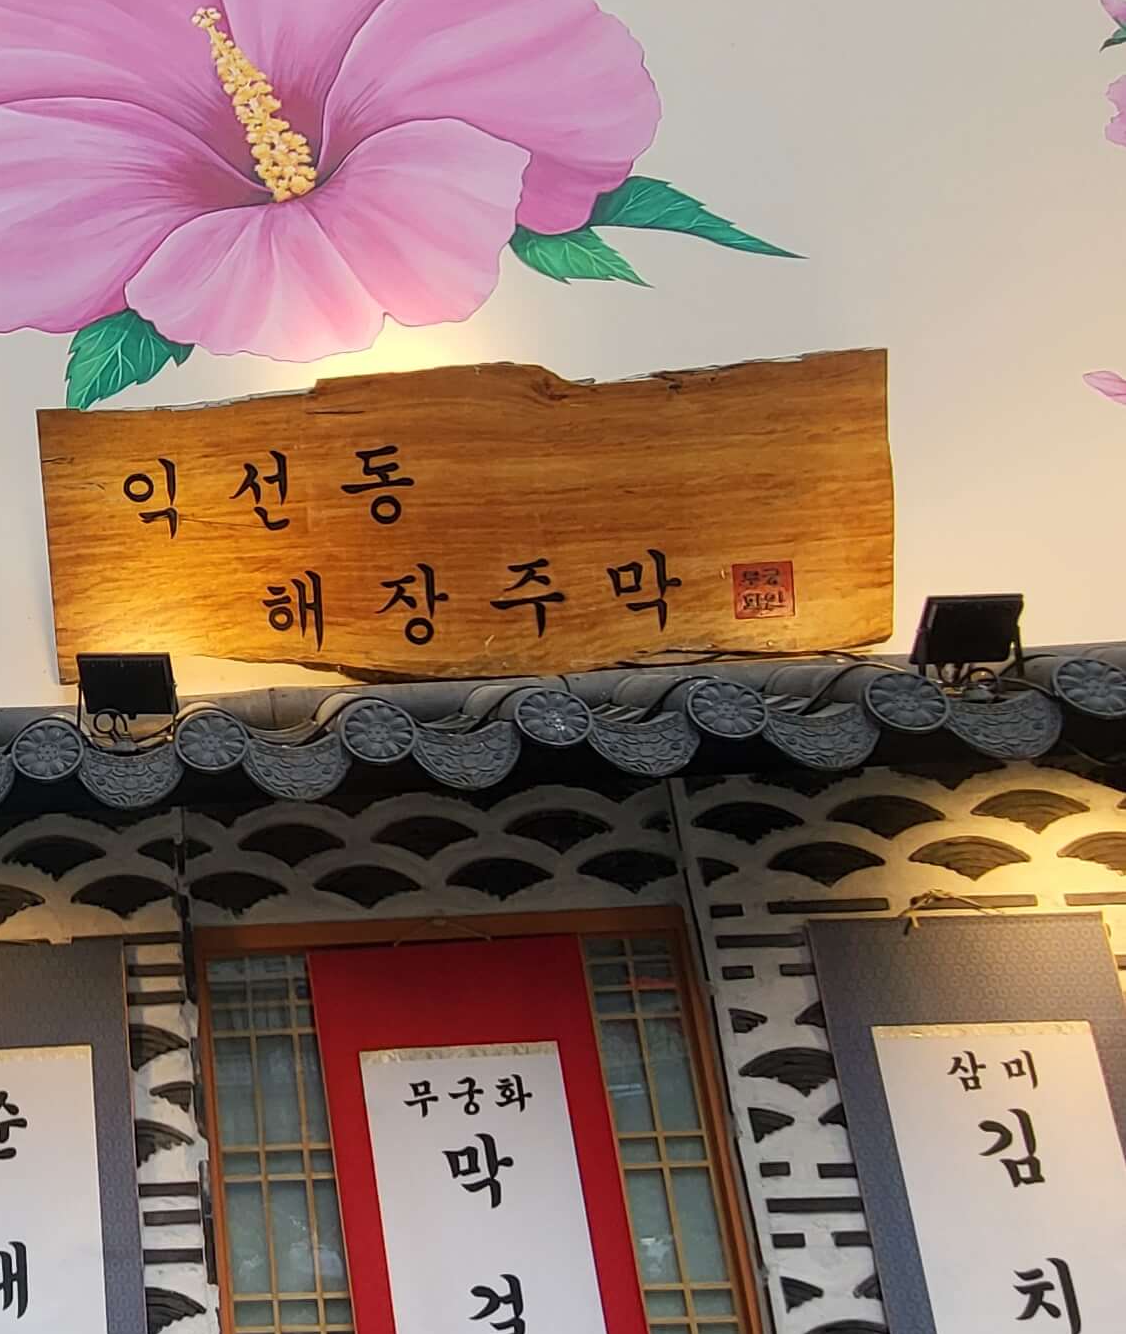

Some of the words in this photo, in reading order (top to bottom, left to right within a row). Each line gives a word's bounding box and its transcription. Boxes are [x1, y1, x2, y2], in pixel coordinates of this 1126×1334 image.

[123, 445, 415, 539] 익선동
[262, 549, 682, 652] 해장주막
[403, 1073, 533, 1118] 무궁화
[947, 1050, 1038, 1092] 삼미
